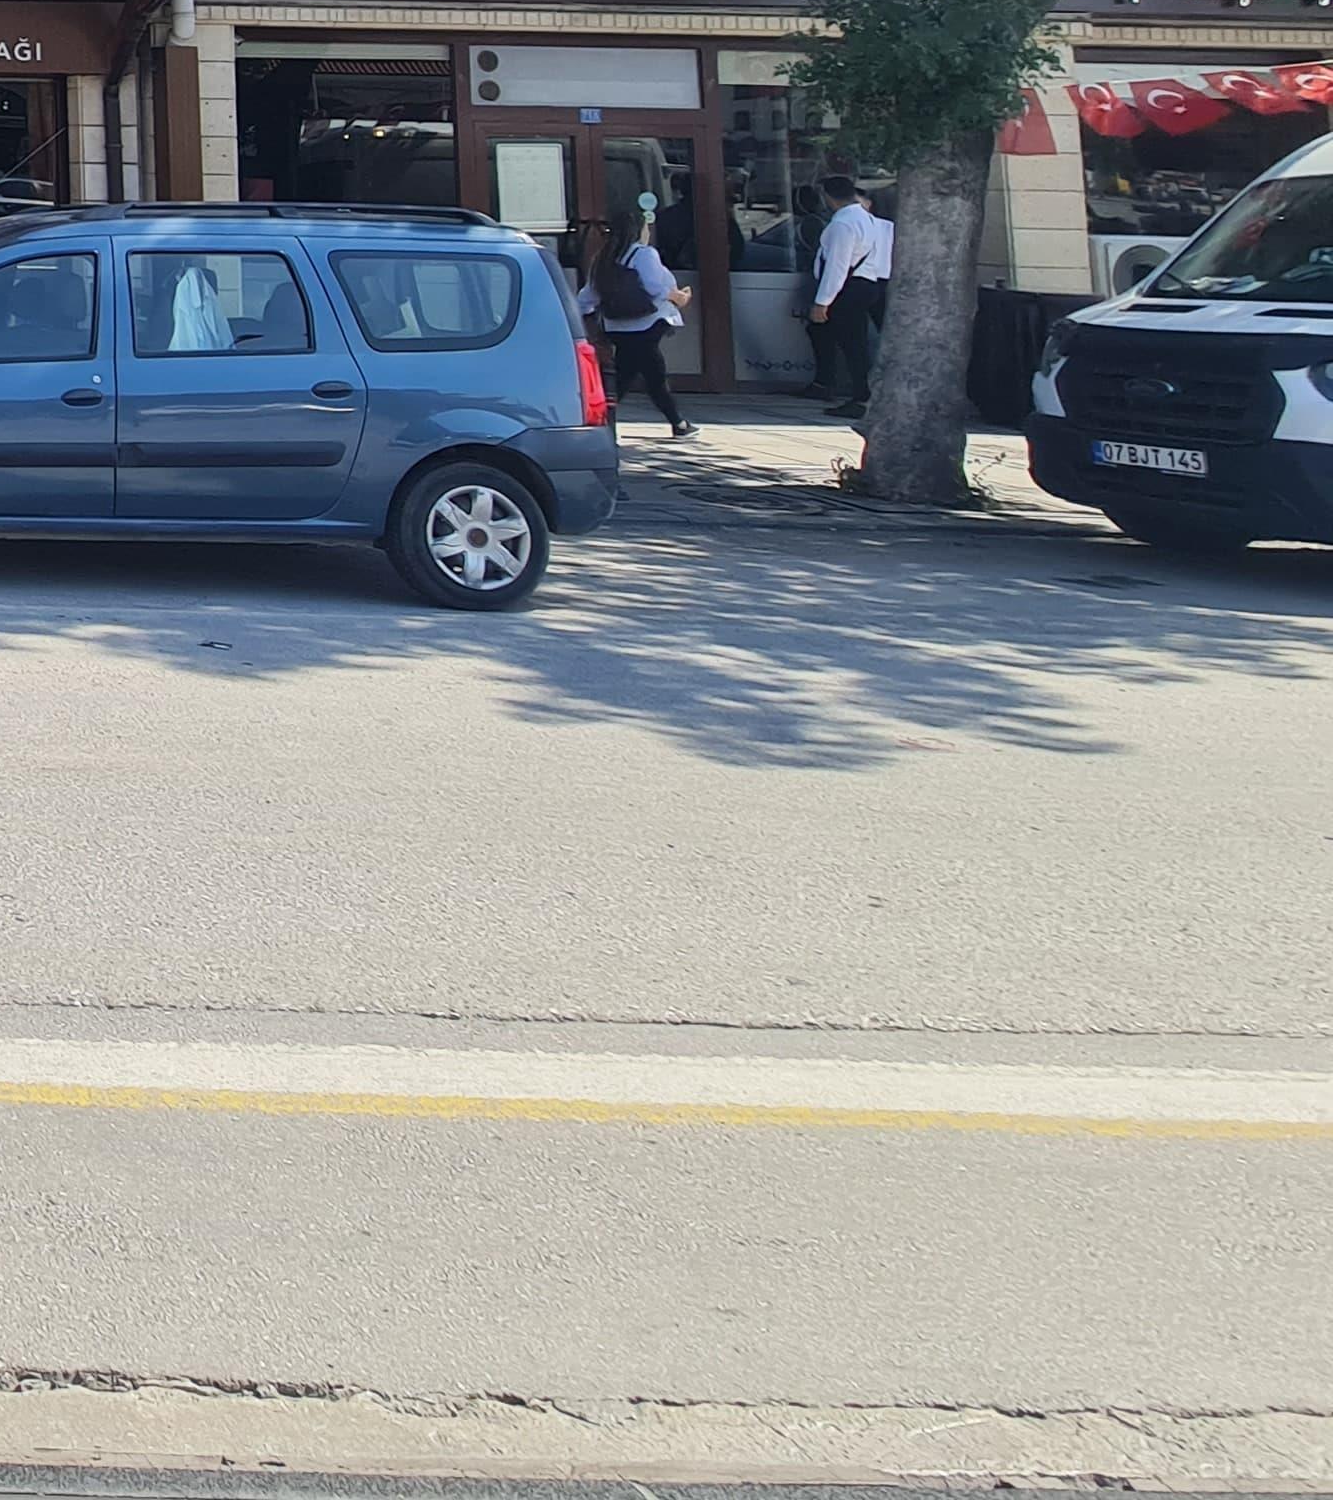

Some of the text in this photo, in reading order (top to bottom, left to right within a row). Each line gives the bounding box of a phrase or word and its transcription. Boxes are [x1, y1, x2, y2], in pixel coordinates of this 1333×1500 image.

[1102, 443, 1202, 470] 07 BJT 145
